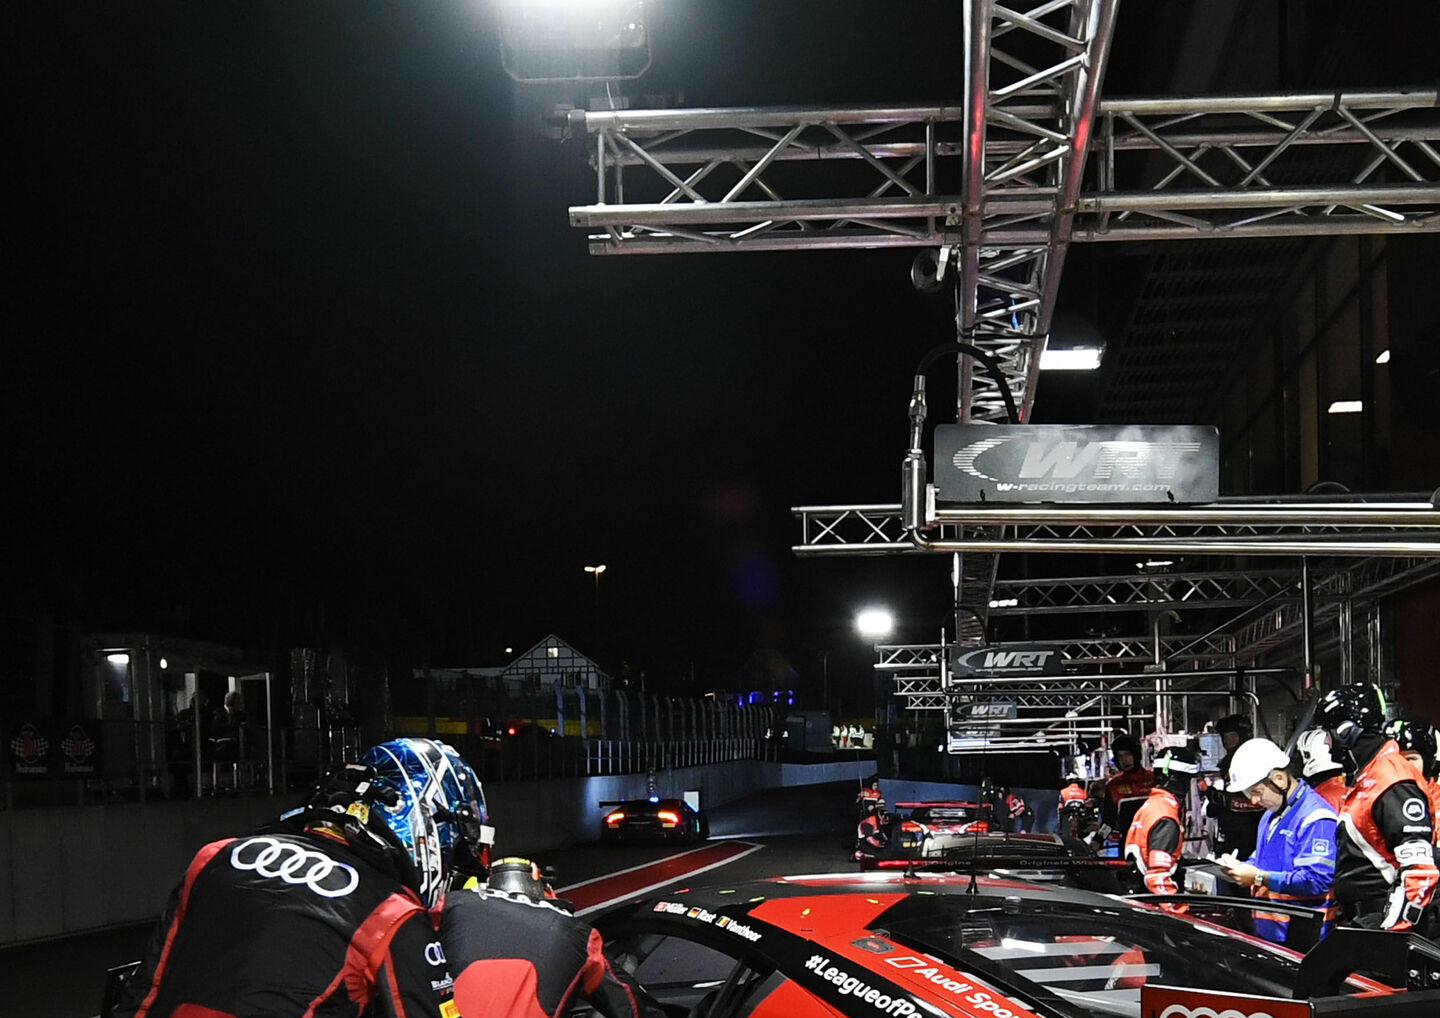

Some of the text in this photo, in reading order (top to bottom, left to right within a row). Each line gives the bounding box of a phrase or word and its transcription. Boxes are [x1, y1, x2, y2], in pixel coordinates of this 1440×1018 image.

[1018, 441, 1201, 479] WRT
[996, 483, 1171, 492] w-racingteam.com
[983, 651, 1054, 668] WRT
[971, 704, 1013, 715] WRT
[726, 919, 762, 942] Vanthoor
[914, 967, 973, 994] Audi
